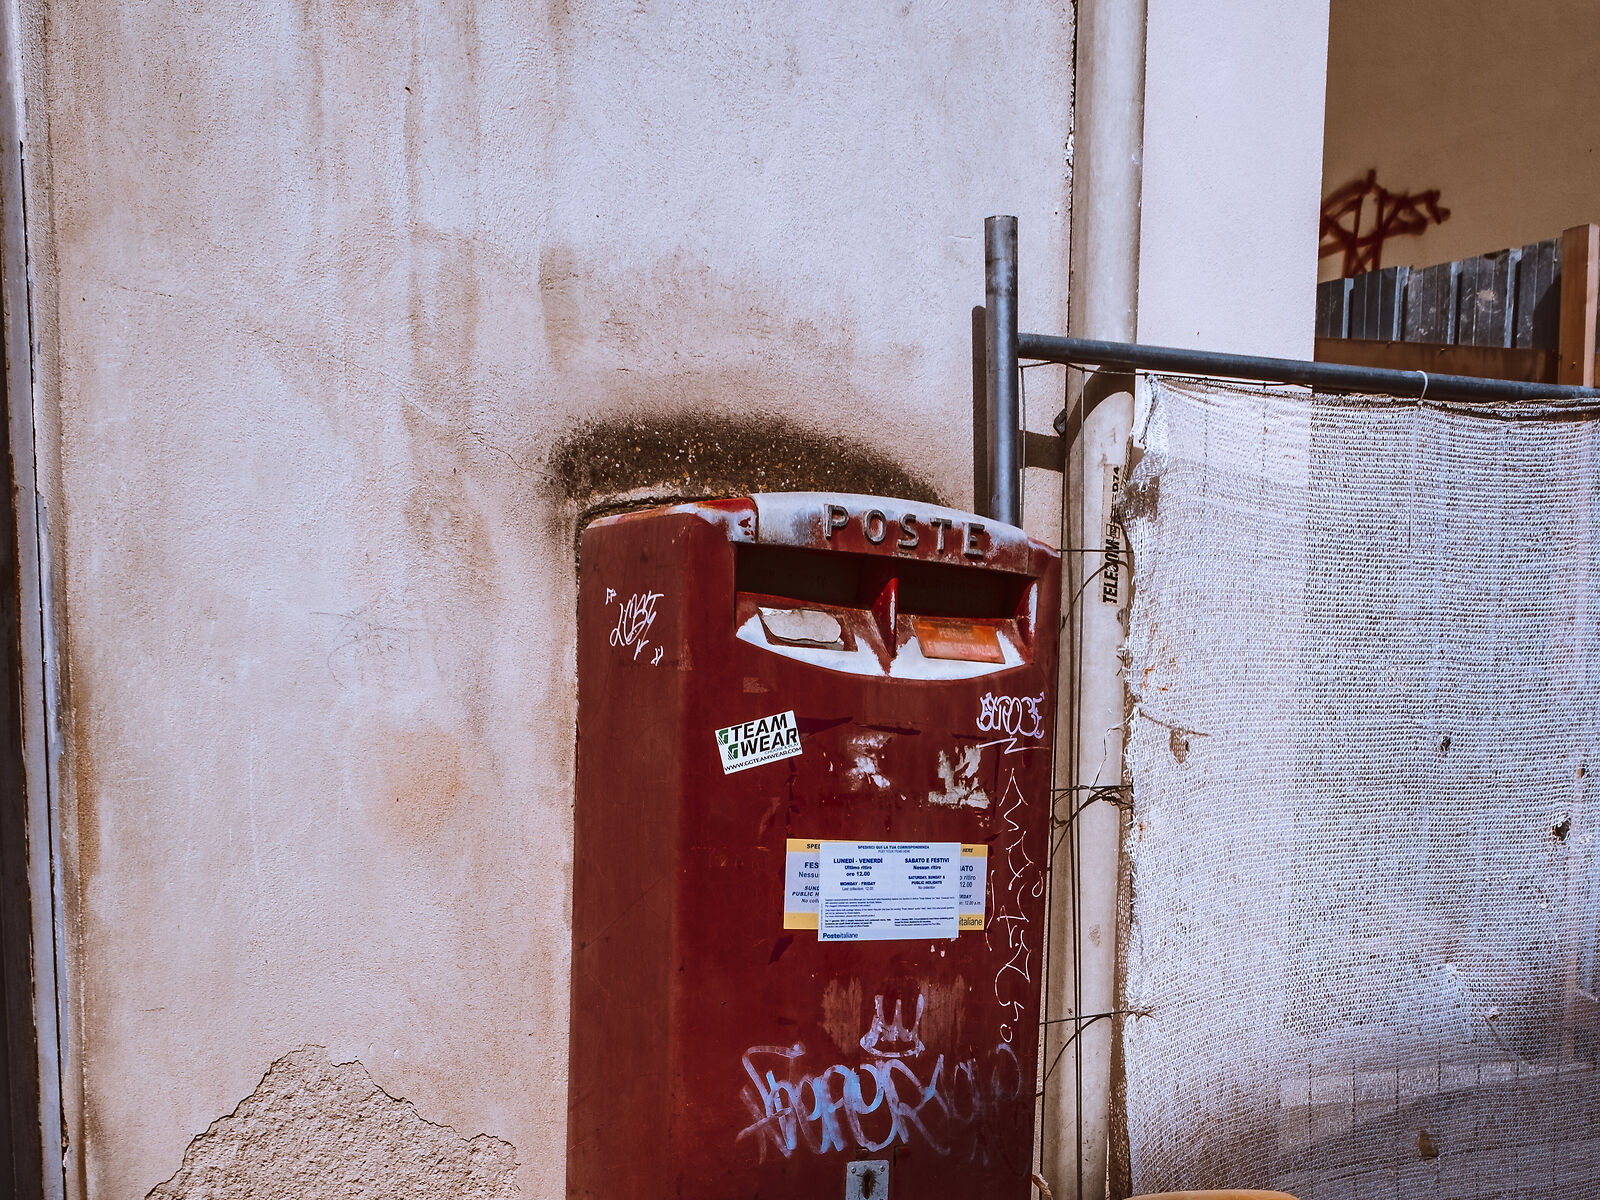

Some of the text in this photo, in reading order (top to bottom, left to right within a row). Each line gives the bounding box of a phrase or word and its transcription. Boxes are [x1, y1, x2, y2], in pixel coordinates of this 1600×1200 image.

[822, 503, 986, 558] POSTE
[731, 713, 787, 742] TEAM
[740, 727, 797, 757] WEAR
